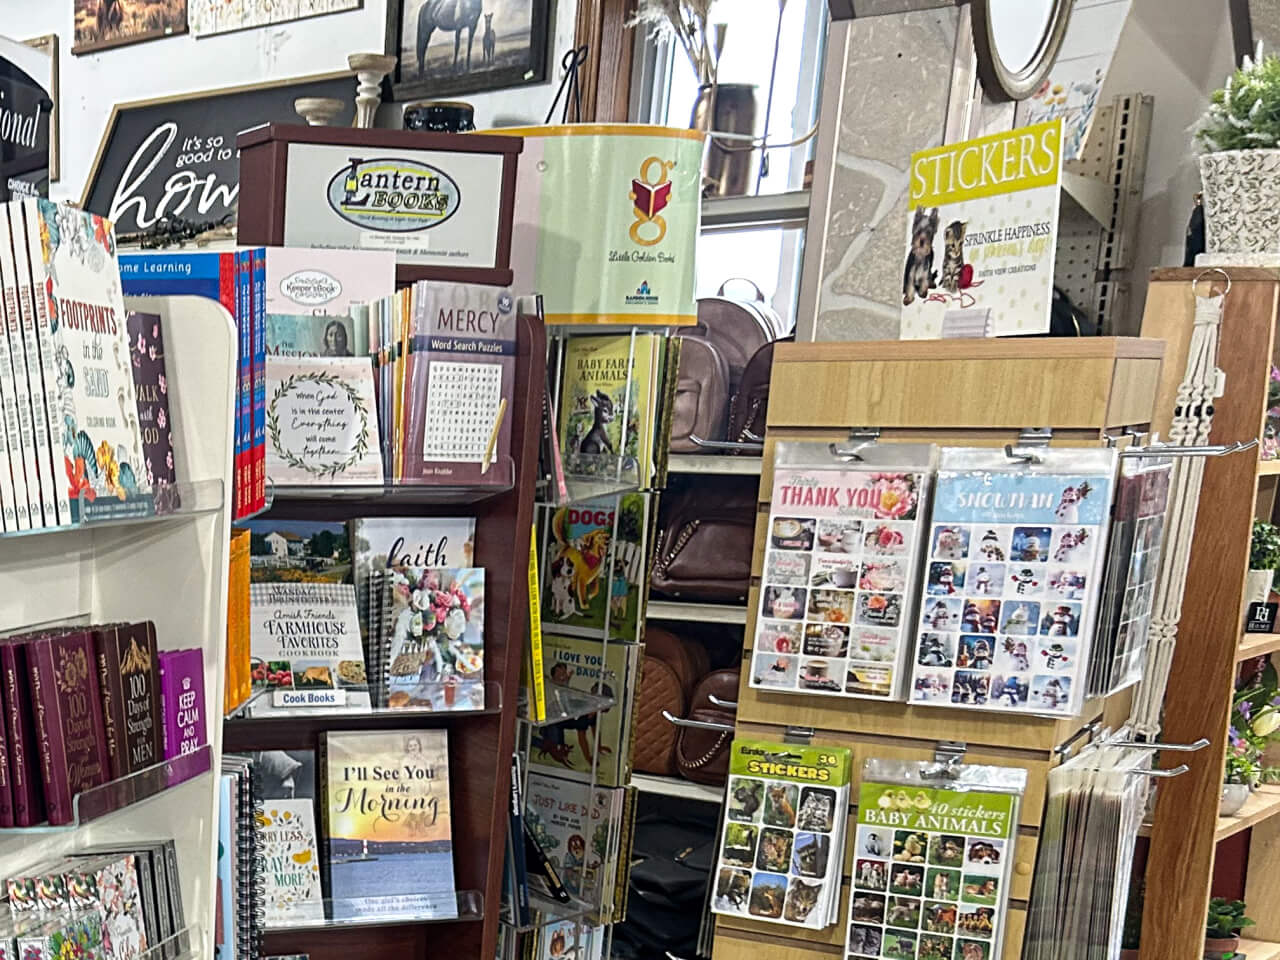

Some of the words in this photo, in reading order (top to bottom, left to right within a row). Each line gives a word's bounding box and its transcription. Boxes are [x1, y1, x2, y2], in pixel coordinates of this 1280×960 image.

[182, 135, 202, 151] It's
[205, 135, 224, 149] so
[175, 148, 212, 167] good
[215, 148, 231, 161] to
[912, 128, 1057, 200] STICKERS
[340, 157, 440, 207] Lantern
[371, 190, 449, 211] BOOKS
[964, 226, 1004, 248] SPRINKLE
[1004, 220, 1052, 243] HAPPINESS
[143, 261, 192, 276] Learning
[437, 307, 500, 334] MERCY
[431, 339, 452, 351] Word
[453, 340, 477, 352] Search
[477, 342, 504, 354] Puzzles
[577, 358, 603, 371] BABY
[579, 369, 629, 382] ANIMALS
[780, 484, 840, 508] THANK
[846, 485, 883, 508] YOU
[957, 490, 1055, 511] SNOWMAN
[567, 507, 616, 528] DOGS
[273, 609, 303, 621] Amish
[303, 609, 336, 621] Friends
[263, 619, 348, 637] FARMHOUSE
[277, 634, 340, 650] FAVORITES
[277, 650, 340, 658] COOKBOOK
[558, 650, 584, 665] LOVE
[130, 674, 146, 700] 100
[179, 690, 197, 710] KEEP
[282, 692, 307, 704] Cook
[307, 692, 336, 704] Books
[176, 707, 200, 728] CALM
[183, 726, 195, 739] AND
[132, 741, 153, 765] MEN
[180, 738, 199, 756] PRAY
[818, 754, 837, 766] 36
[342, 766, 368, 782] I'll
[372, 766, 400, 782] See
[403, 765, 436, 781] You
[747, 760, 831, 782] STICKERS
[333, 785, 441, 826] Morning
[531, 793, 554, 811] JUST
[554, 798, 579, 816] LIKE
[929, 801, 950, 815] 40
[949, 806, 1008, 821] stickers
[863, 808, 914, 828] BABY
[914, 814, 1004, 837] ANIMALS
[273, 872, 306, 887] MORE
